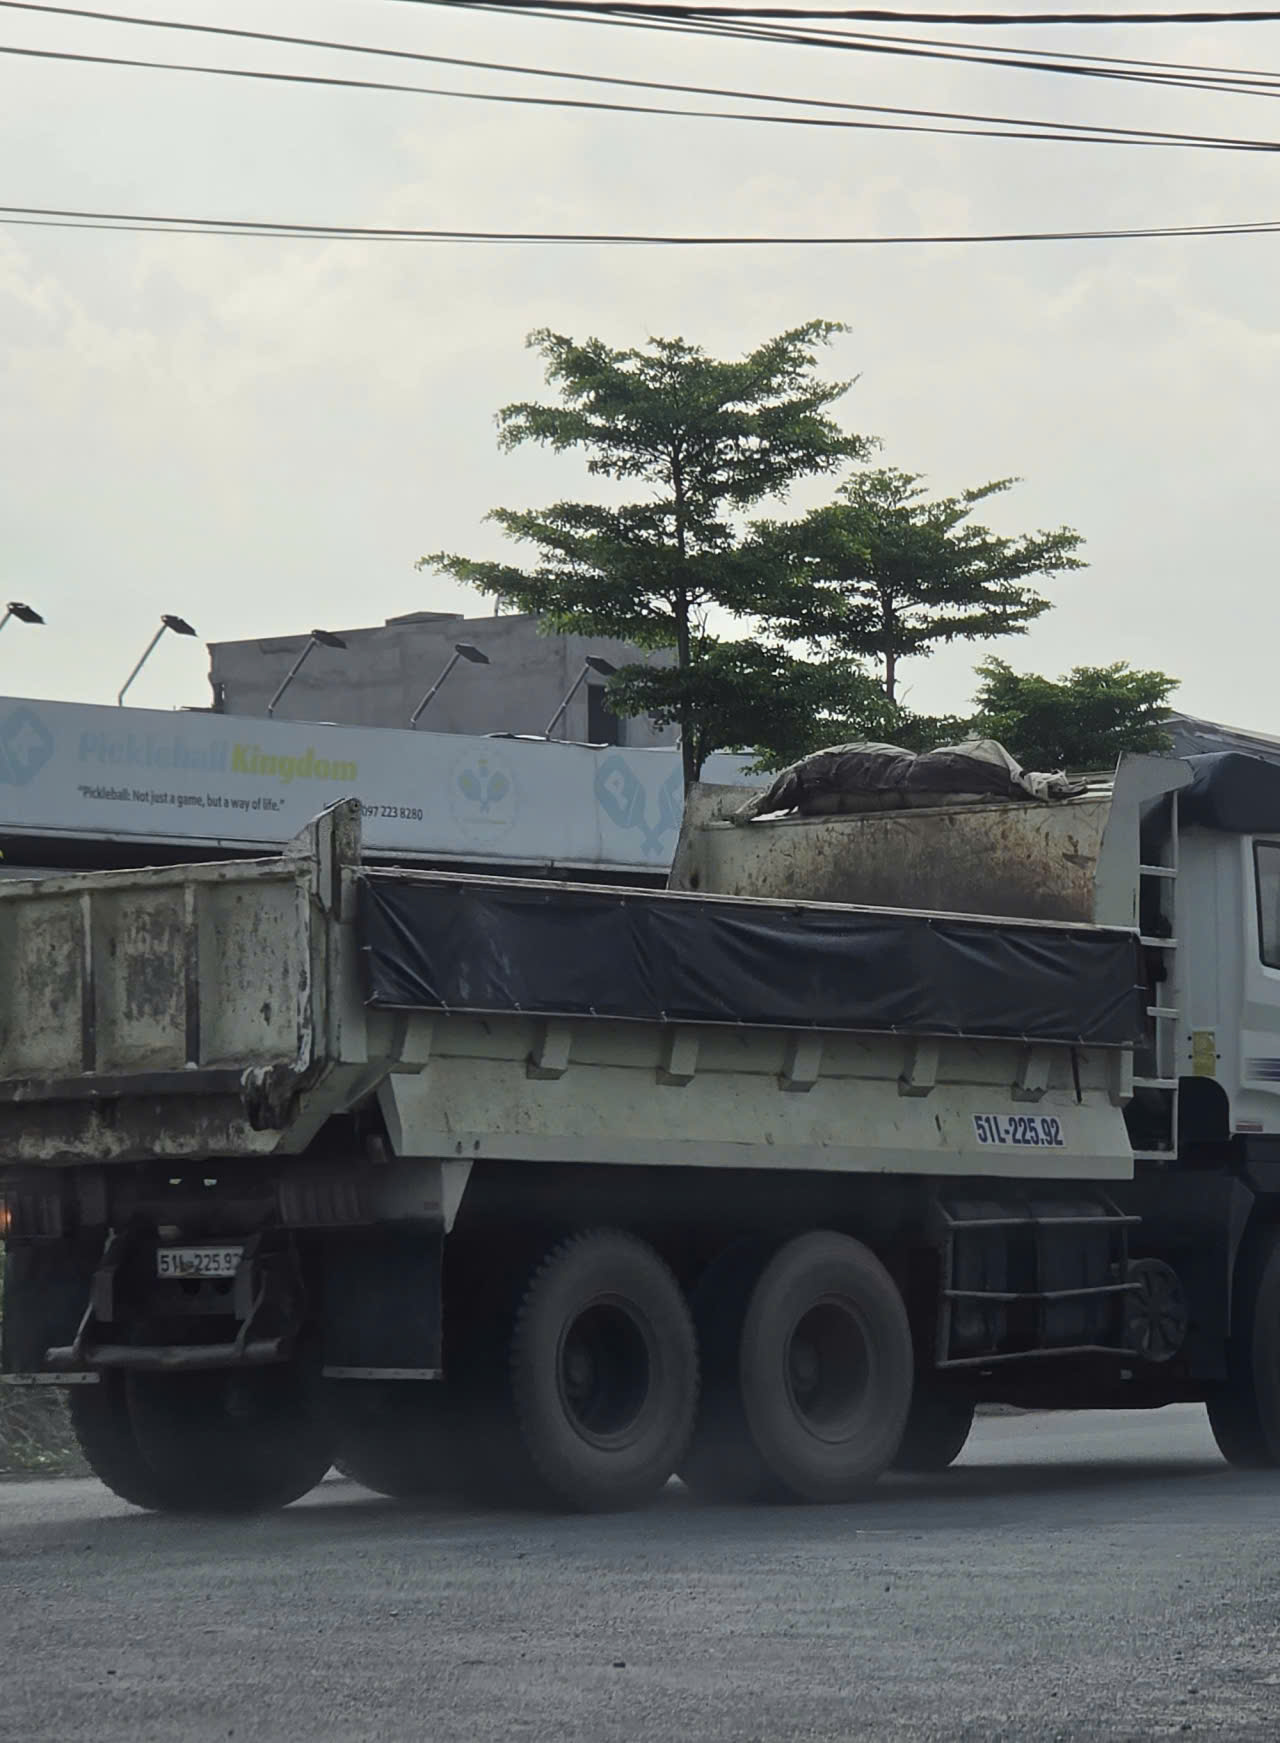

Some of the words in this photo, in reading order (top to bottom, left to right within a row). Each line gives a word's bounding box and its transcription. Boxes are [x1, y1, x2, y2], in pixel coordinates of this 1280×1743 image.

[79, 732, 227, 772] Pickleball
[232, 743, 357, 784] Kingdom
[132, 789, 149, 802] Not
[150, 791, 167, 806] just
[169, 794, 175, 804] a
[177, 794, 205, 808] game,
[207, 794, 222, 807] but
[223, 798, 230, 808] a
[231, 798, 250, 812] way
[251, 797, 261, 810] of
[381, 806, 397, 819] 223
[400, 807, 423, 821] 8280
[974, 1115, 1064, 1145] 51L-225.92
